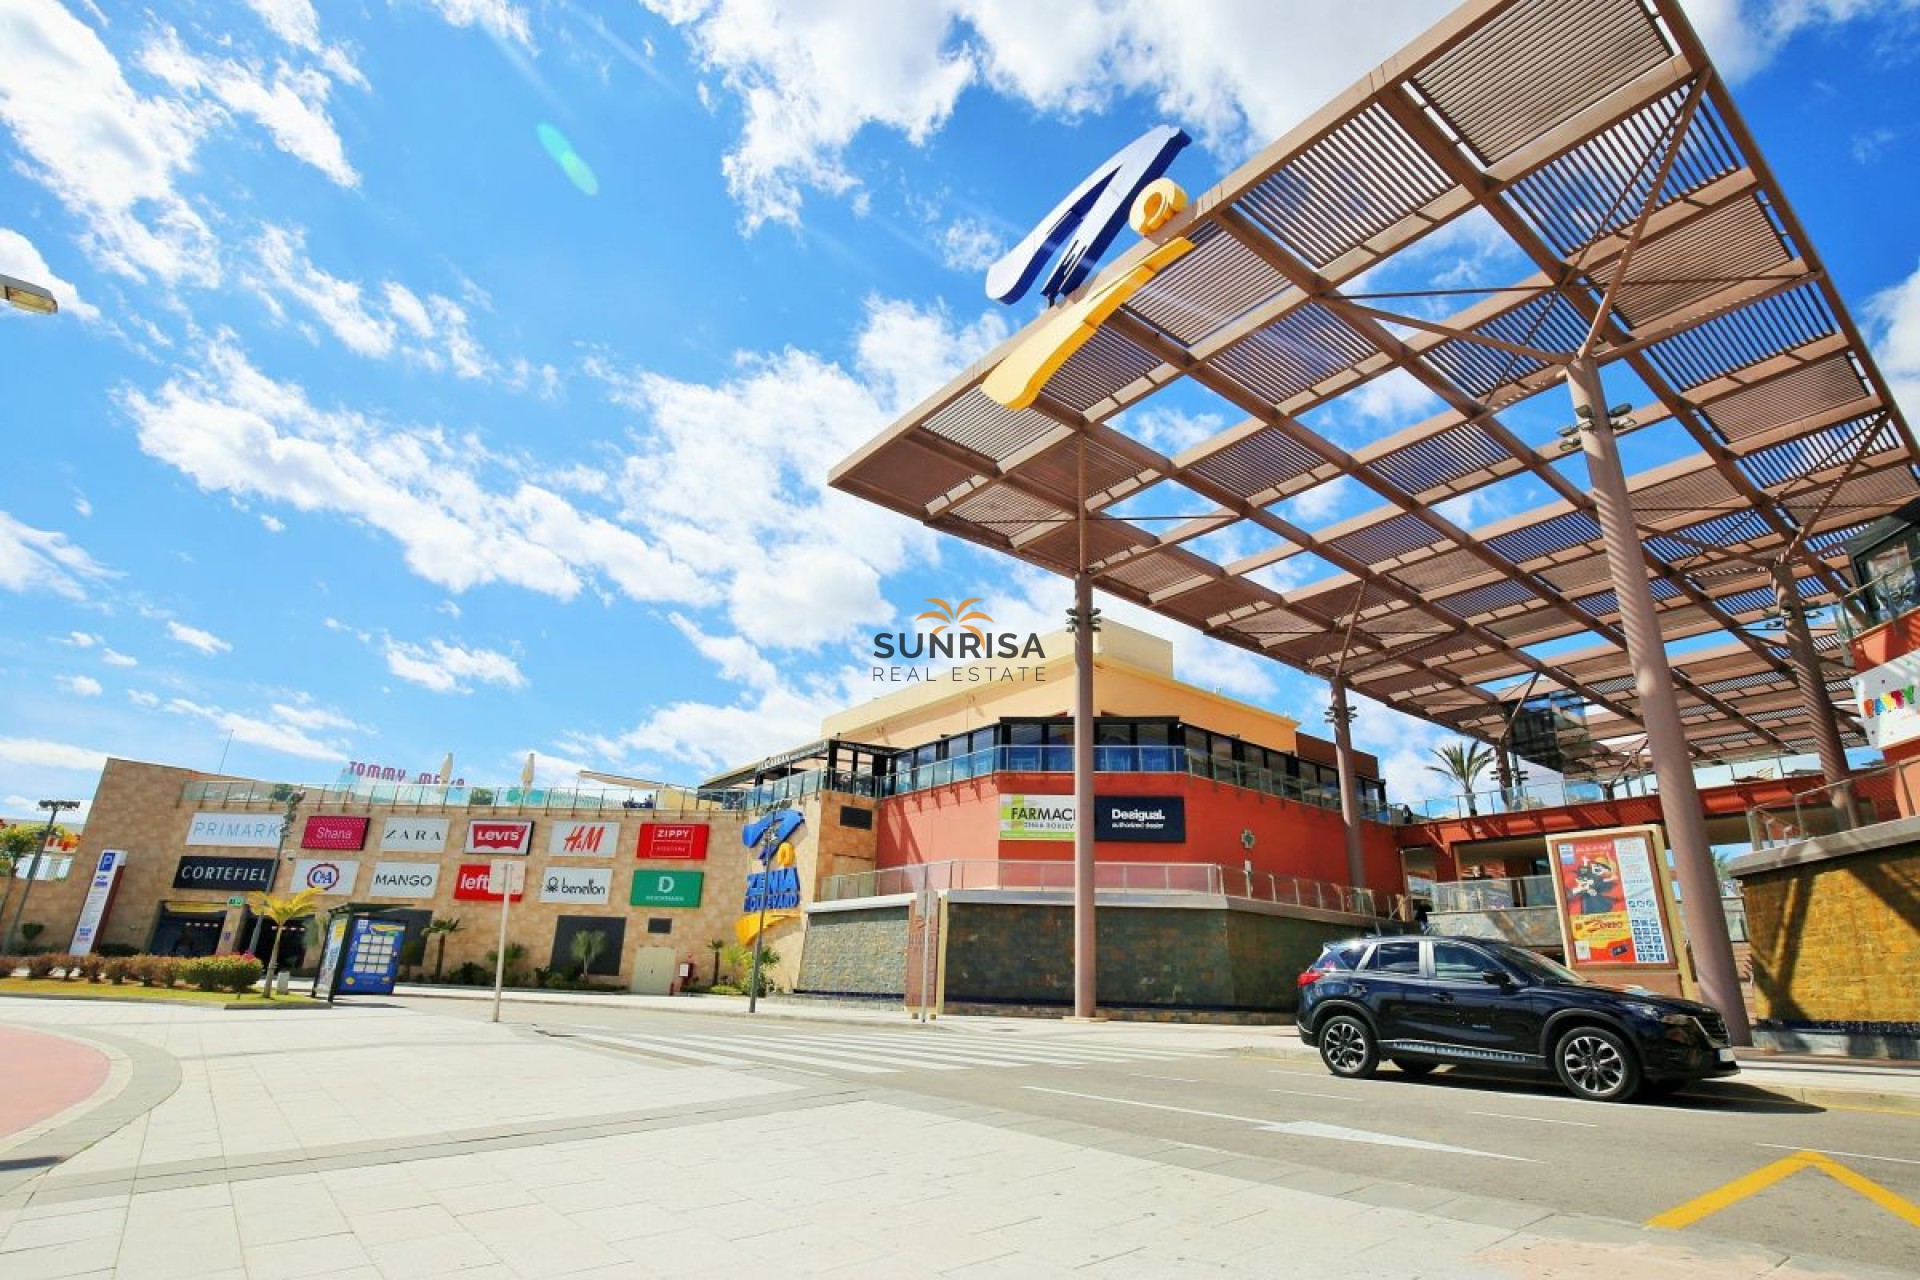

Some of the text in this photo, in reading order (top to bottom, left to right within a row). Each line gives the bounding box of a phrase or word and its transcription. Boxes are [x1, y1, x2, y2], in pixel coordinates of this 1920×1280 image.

[349, 761, 407, 781] TOMMY
[1011, 807, 1076, 821] FARMACI
[193, 822, 280, 838] PRIMARK
[316, 826, 352, 840] Shana
[385, 829, 441, 841] ZARA
[657, 829, 690, 838] ZIPPY
[564, 825, 605, 852] H&M
[181, 865, 267, 881] CORTEFIEL
[375, 874, 433, 886] MANGO
[460, 874, 490, 889] left
[658, 876, 675, 893] D
[745, 867, 800, 896] ZENIA
